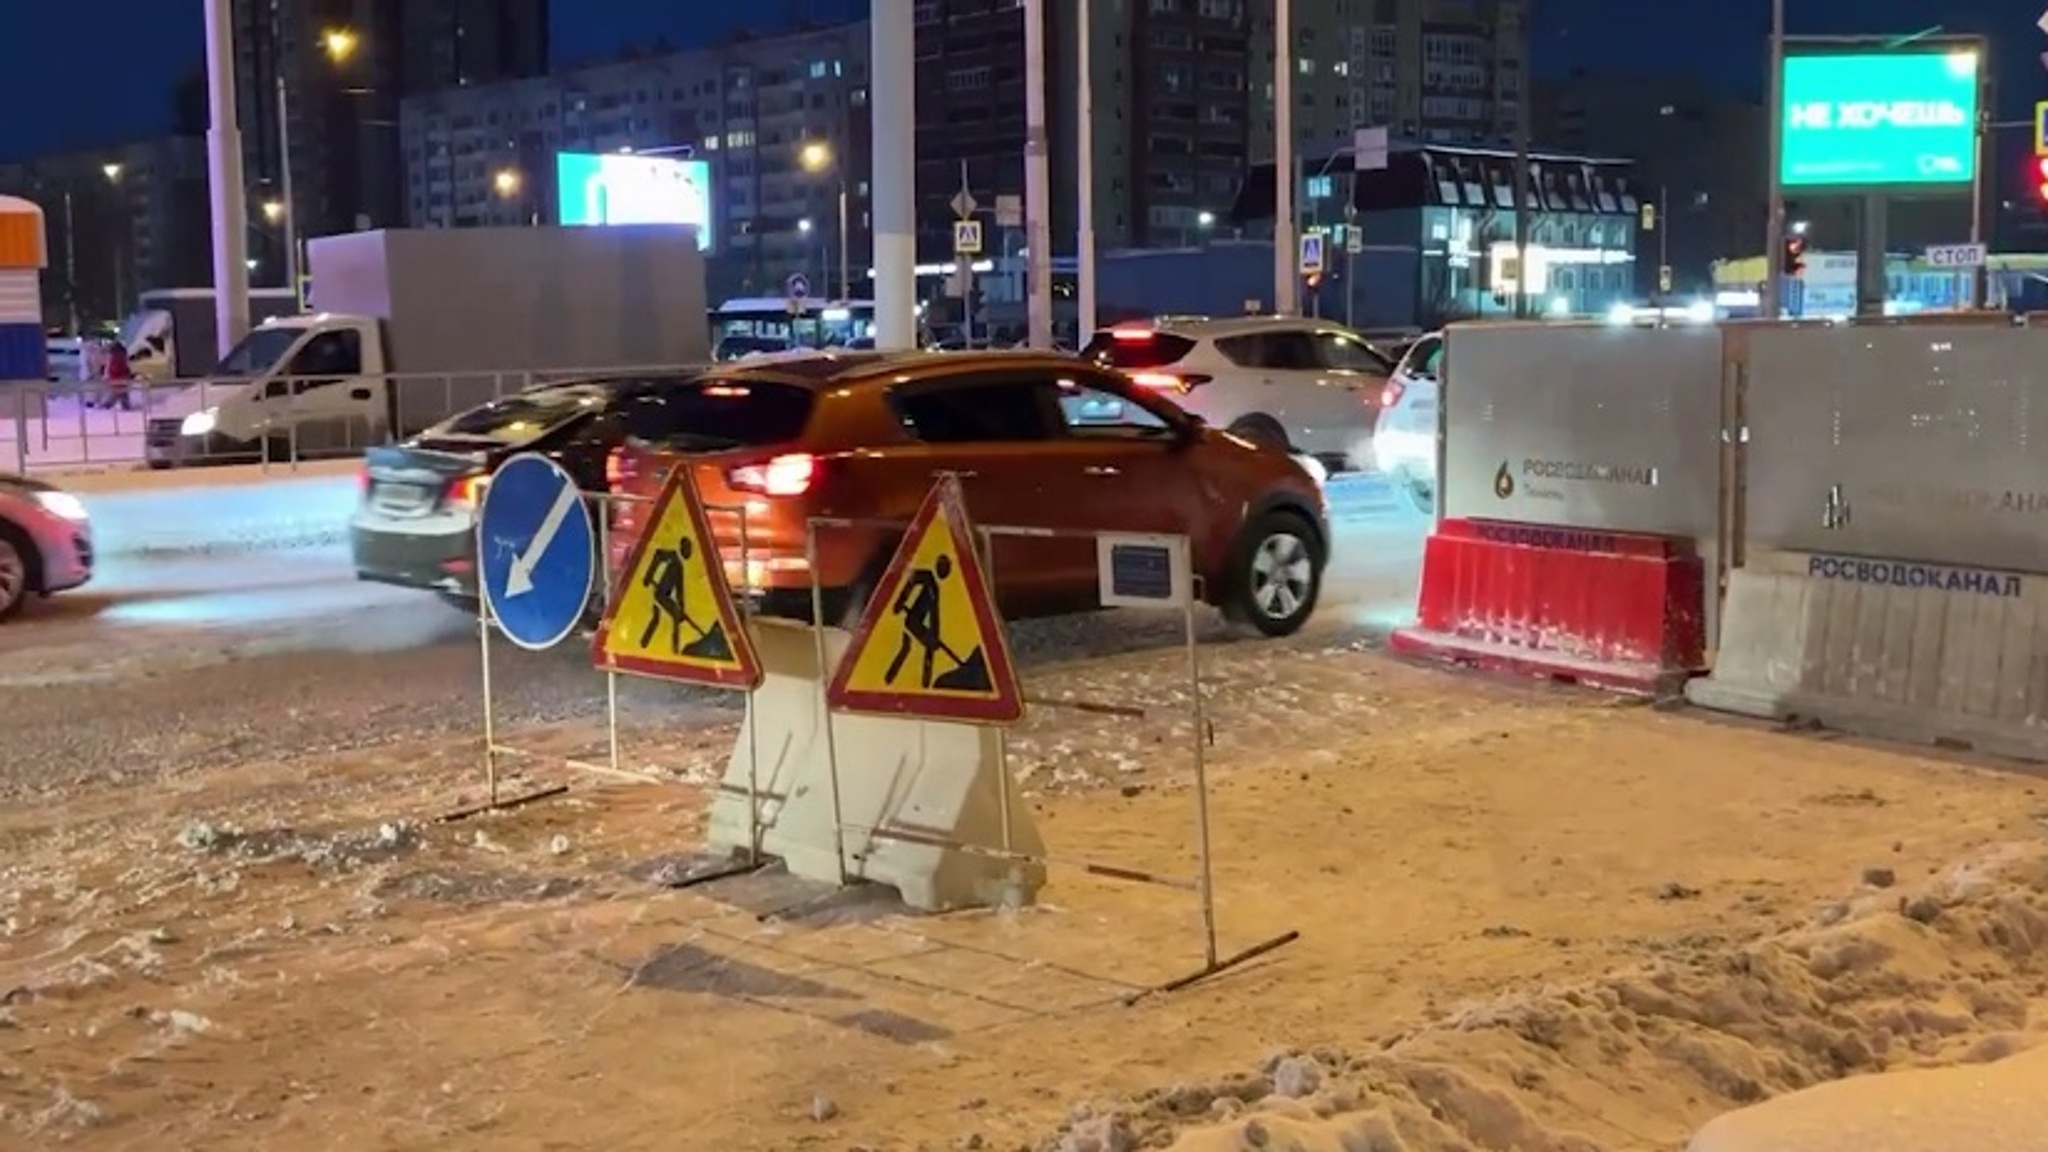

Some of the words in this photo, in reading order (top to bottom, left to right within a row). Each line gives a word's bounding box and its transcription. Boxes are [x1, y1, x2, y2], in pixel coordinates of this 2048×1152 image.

[1791, 102, 1832, 129] НЕ
[1837, 100, 1966, 129] ХОЧЕШЬ
[1932, 248, 1979, 264] СТОП
[1808, 555, 2022, 597] РОСВОДОКАНАЛ
